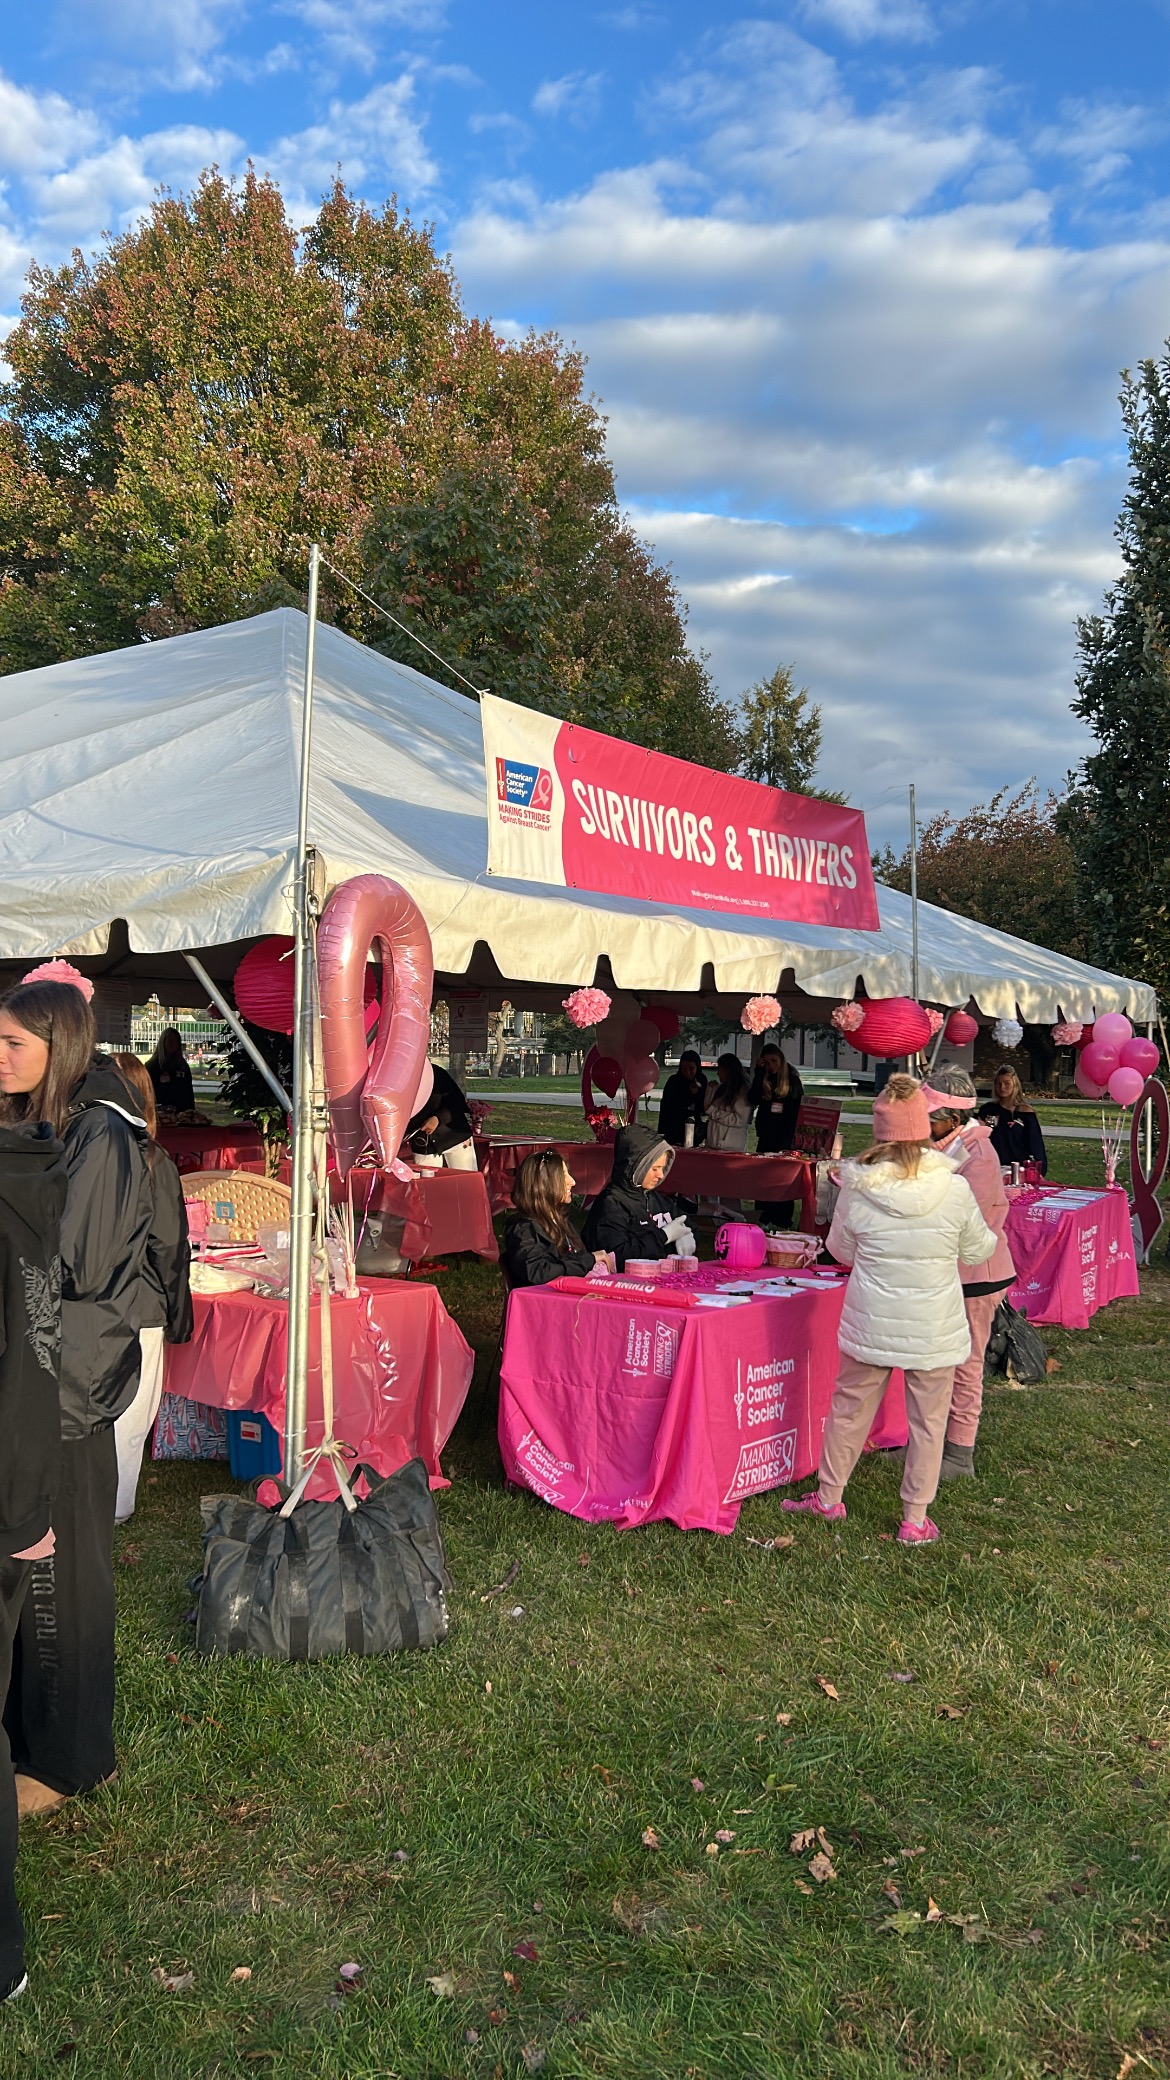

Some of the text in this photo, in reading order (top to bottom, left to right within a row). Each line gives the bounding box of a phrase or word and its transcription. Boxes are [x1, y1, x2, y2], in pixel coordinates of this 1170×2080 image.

[506, 770, 533, 783] American
[506, 777, 525, 788] Cancer
[498, 803, 551, 824] MAKING STRIDES
[499, 813, 518, 824] Against
[517, 817, 534, 829] Breast
[571, 779, 858, 890] SURVIVORS & THRIVERS
[588, 1278, 645, 1292] THINK PINK
[625, 1318, 636, 1365] American
[632, 1330, 643, 1366] Cancer
[641, 1329, 652, 1367] Society
[655, 1336, 665, 1373] MAKING
[663, 1340, 673, 1376] STRIDES
[746, 1358, 795, 1384] American
[746, 1381, 784, 1405] Cancer
[747, 1400, 786, 1427] Society
[524, 1452, 562, 1486] Society
[529, 1444, 564, 1478] Cancer
[741, 1439, 783, 1469] MAKING
[736, 1460, 780, 1489] STRIDES
[31, 1556, 56, 1596] ETA
[34, 1601, 58, 1640] TAU
